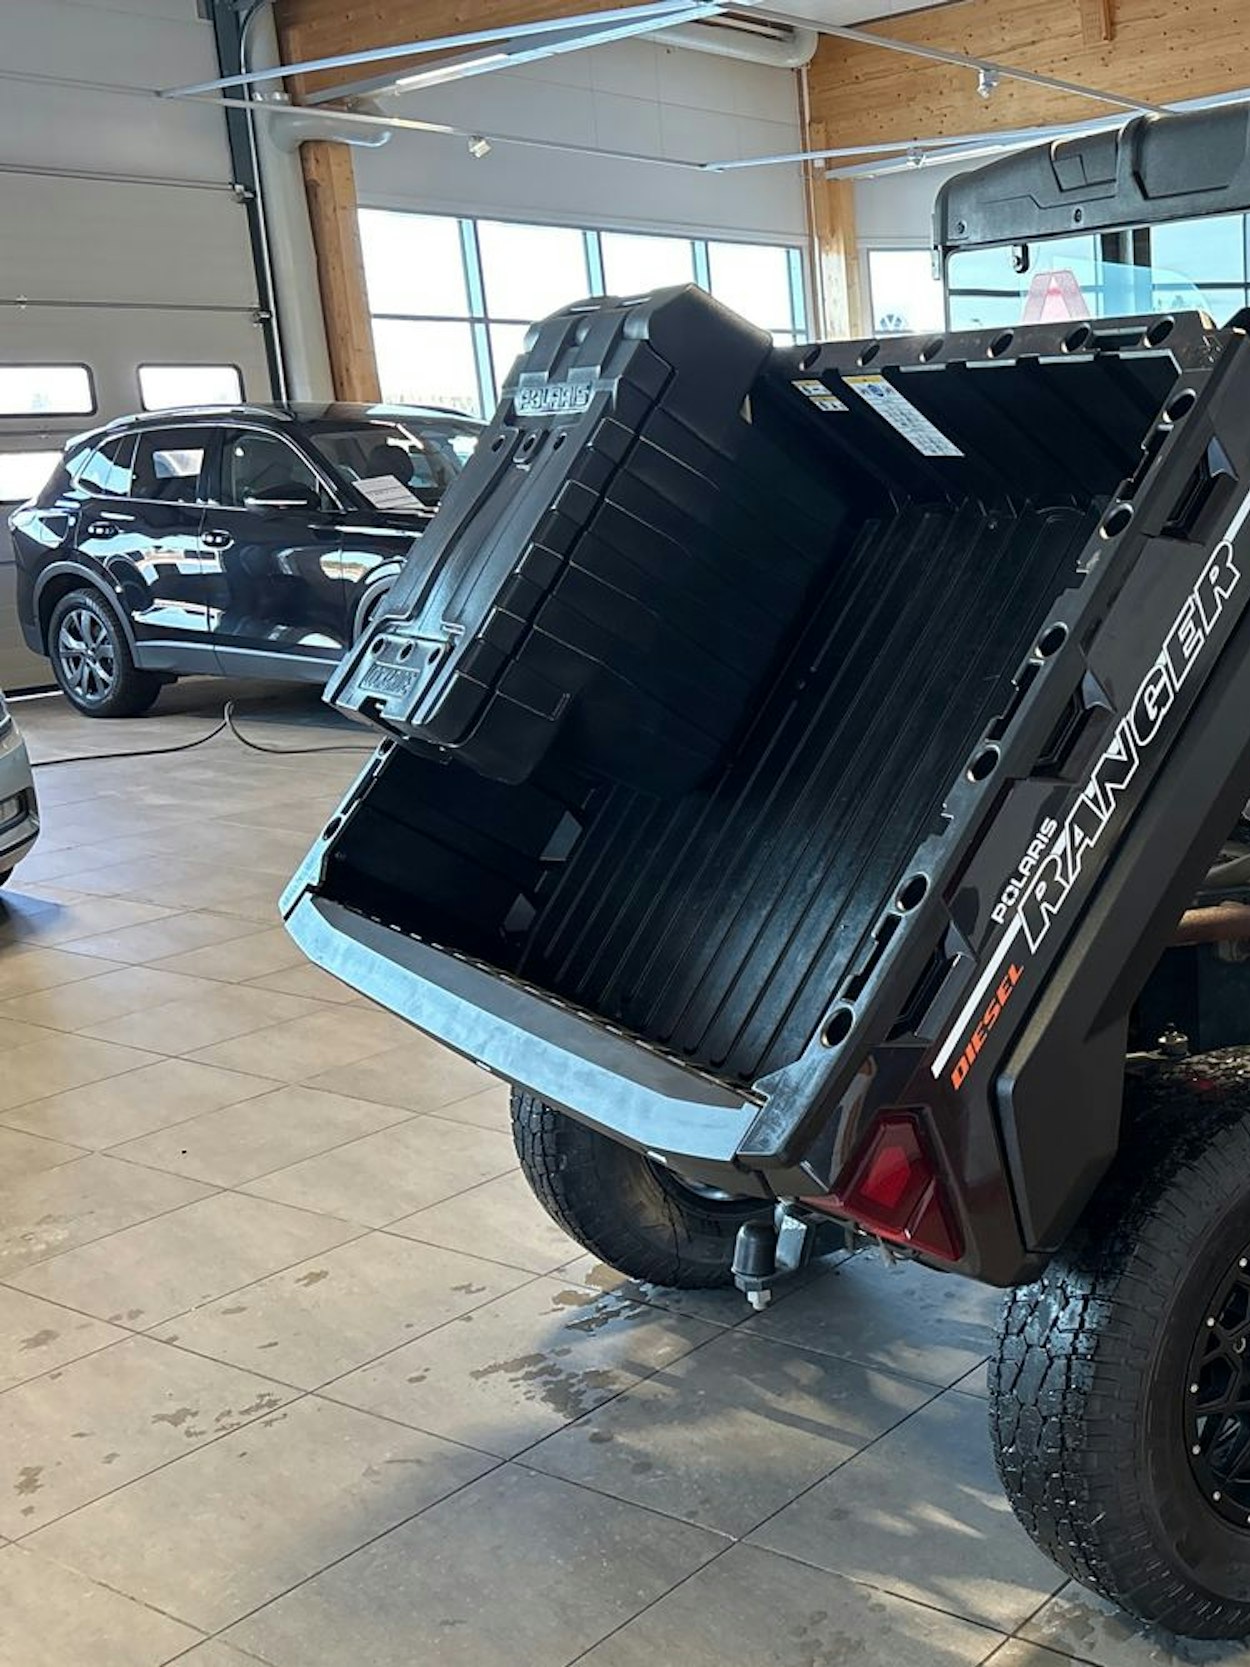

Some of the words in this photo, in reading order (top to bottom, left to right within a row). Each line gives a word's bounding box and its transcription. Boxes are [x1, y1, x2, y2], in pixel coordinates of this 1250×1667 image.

[1017, 539, 1241, 954] RANGER
[991, 817, 1059, 925] POLARIS
[950, 963, 1025, 1091] DIESEL
